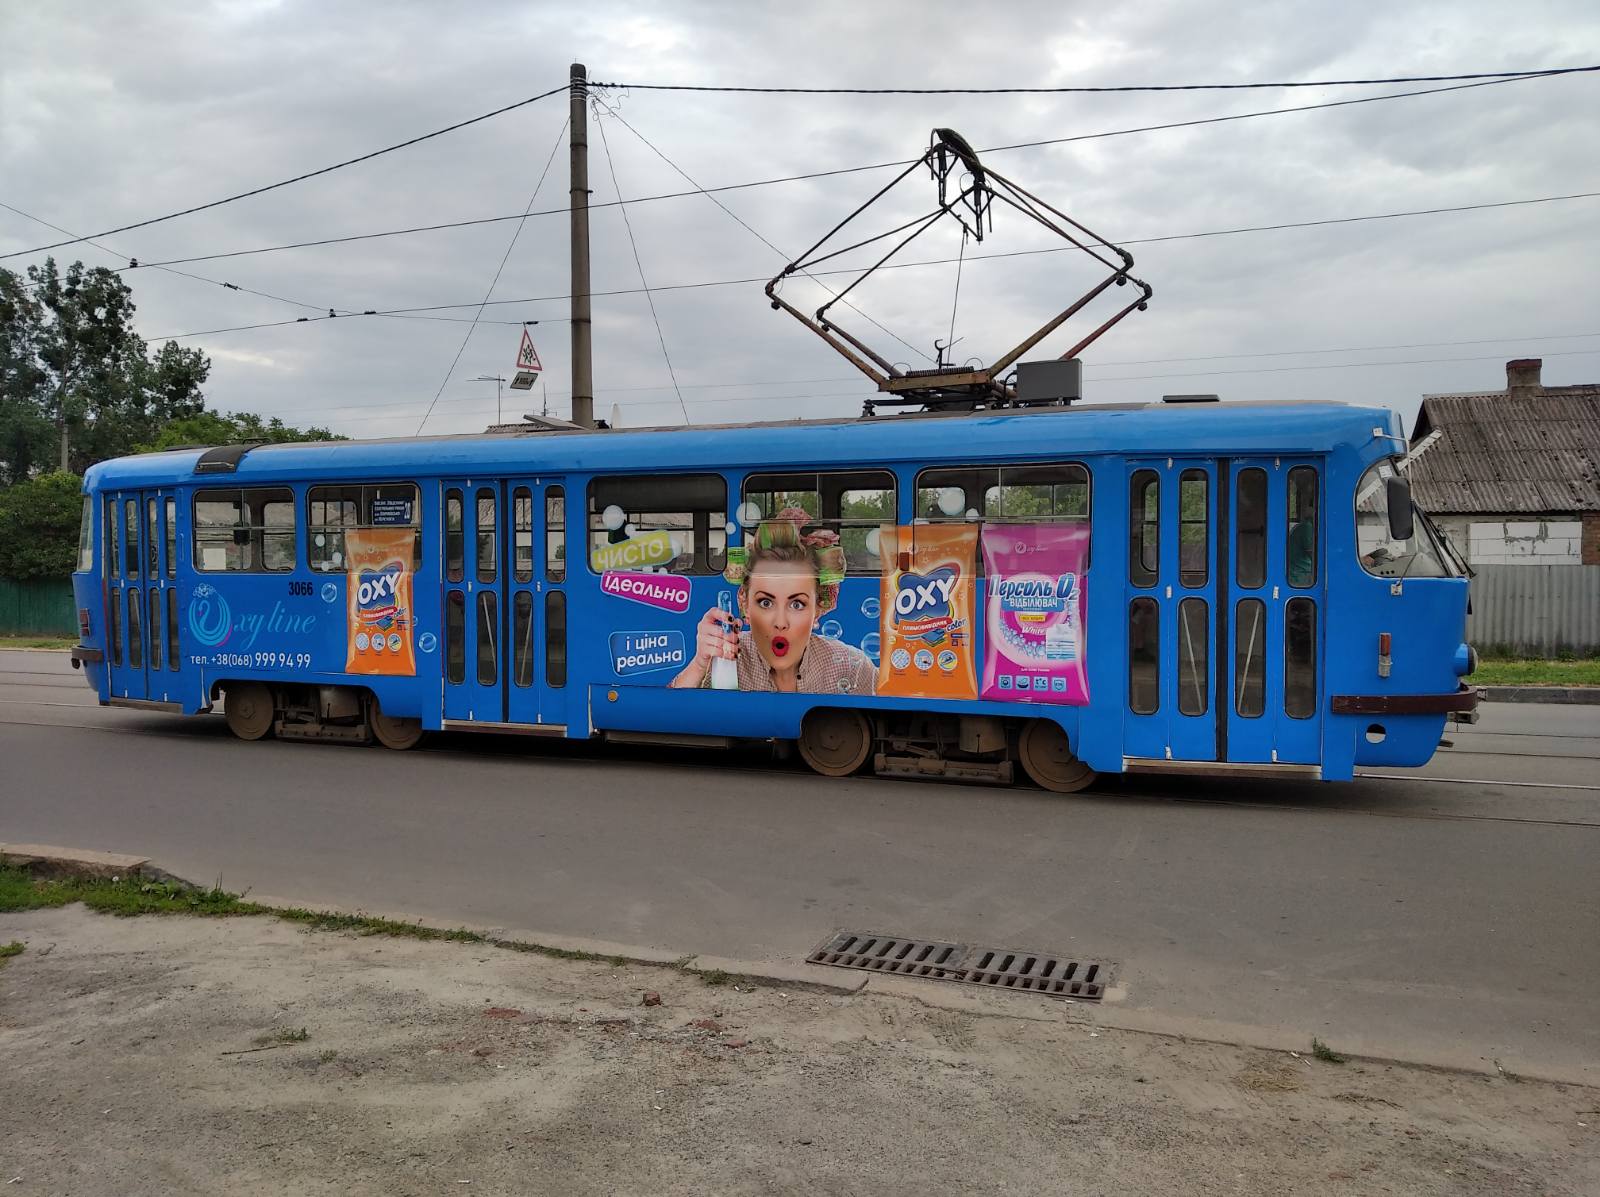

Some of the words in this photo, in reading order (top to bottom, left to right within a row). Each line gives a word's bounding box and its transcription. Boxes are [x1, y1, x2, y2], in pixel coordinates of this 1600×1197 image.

[595, 537, 665, 570] ЧИСТО
[288, 582, 314, 597] 3066
[357, 571, 401, 605] OXY
[604, 571, 689, 605] ідеально
[895, 575, 956, 616] OXY
[989, 575, 1053, 599] Персоль
[1009, 598, 1058, 609] ВІДБІЛЮВАЧ
[635, 635, 668, 653] ціна
[190, 654, 210, 665] тел.
[211, 653, 253, 667] +38(068)
[255, 652, 276, 667] 999
[278, 653, 294, 667] 94
[296, 654, 311, 668] 99
[616, 648, 682, 671] реальна
